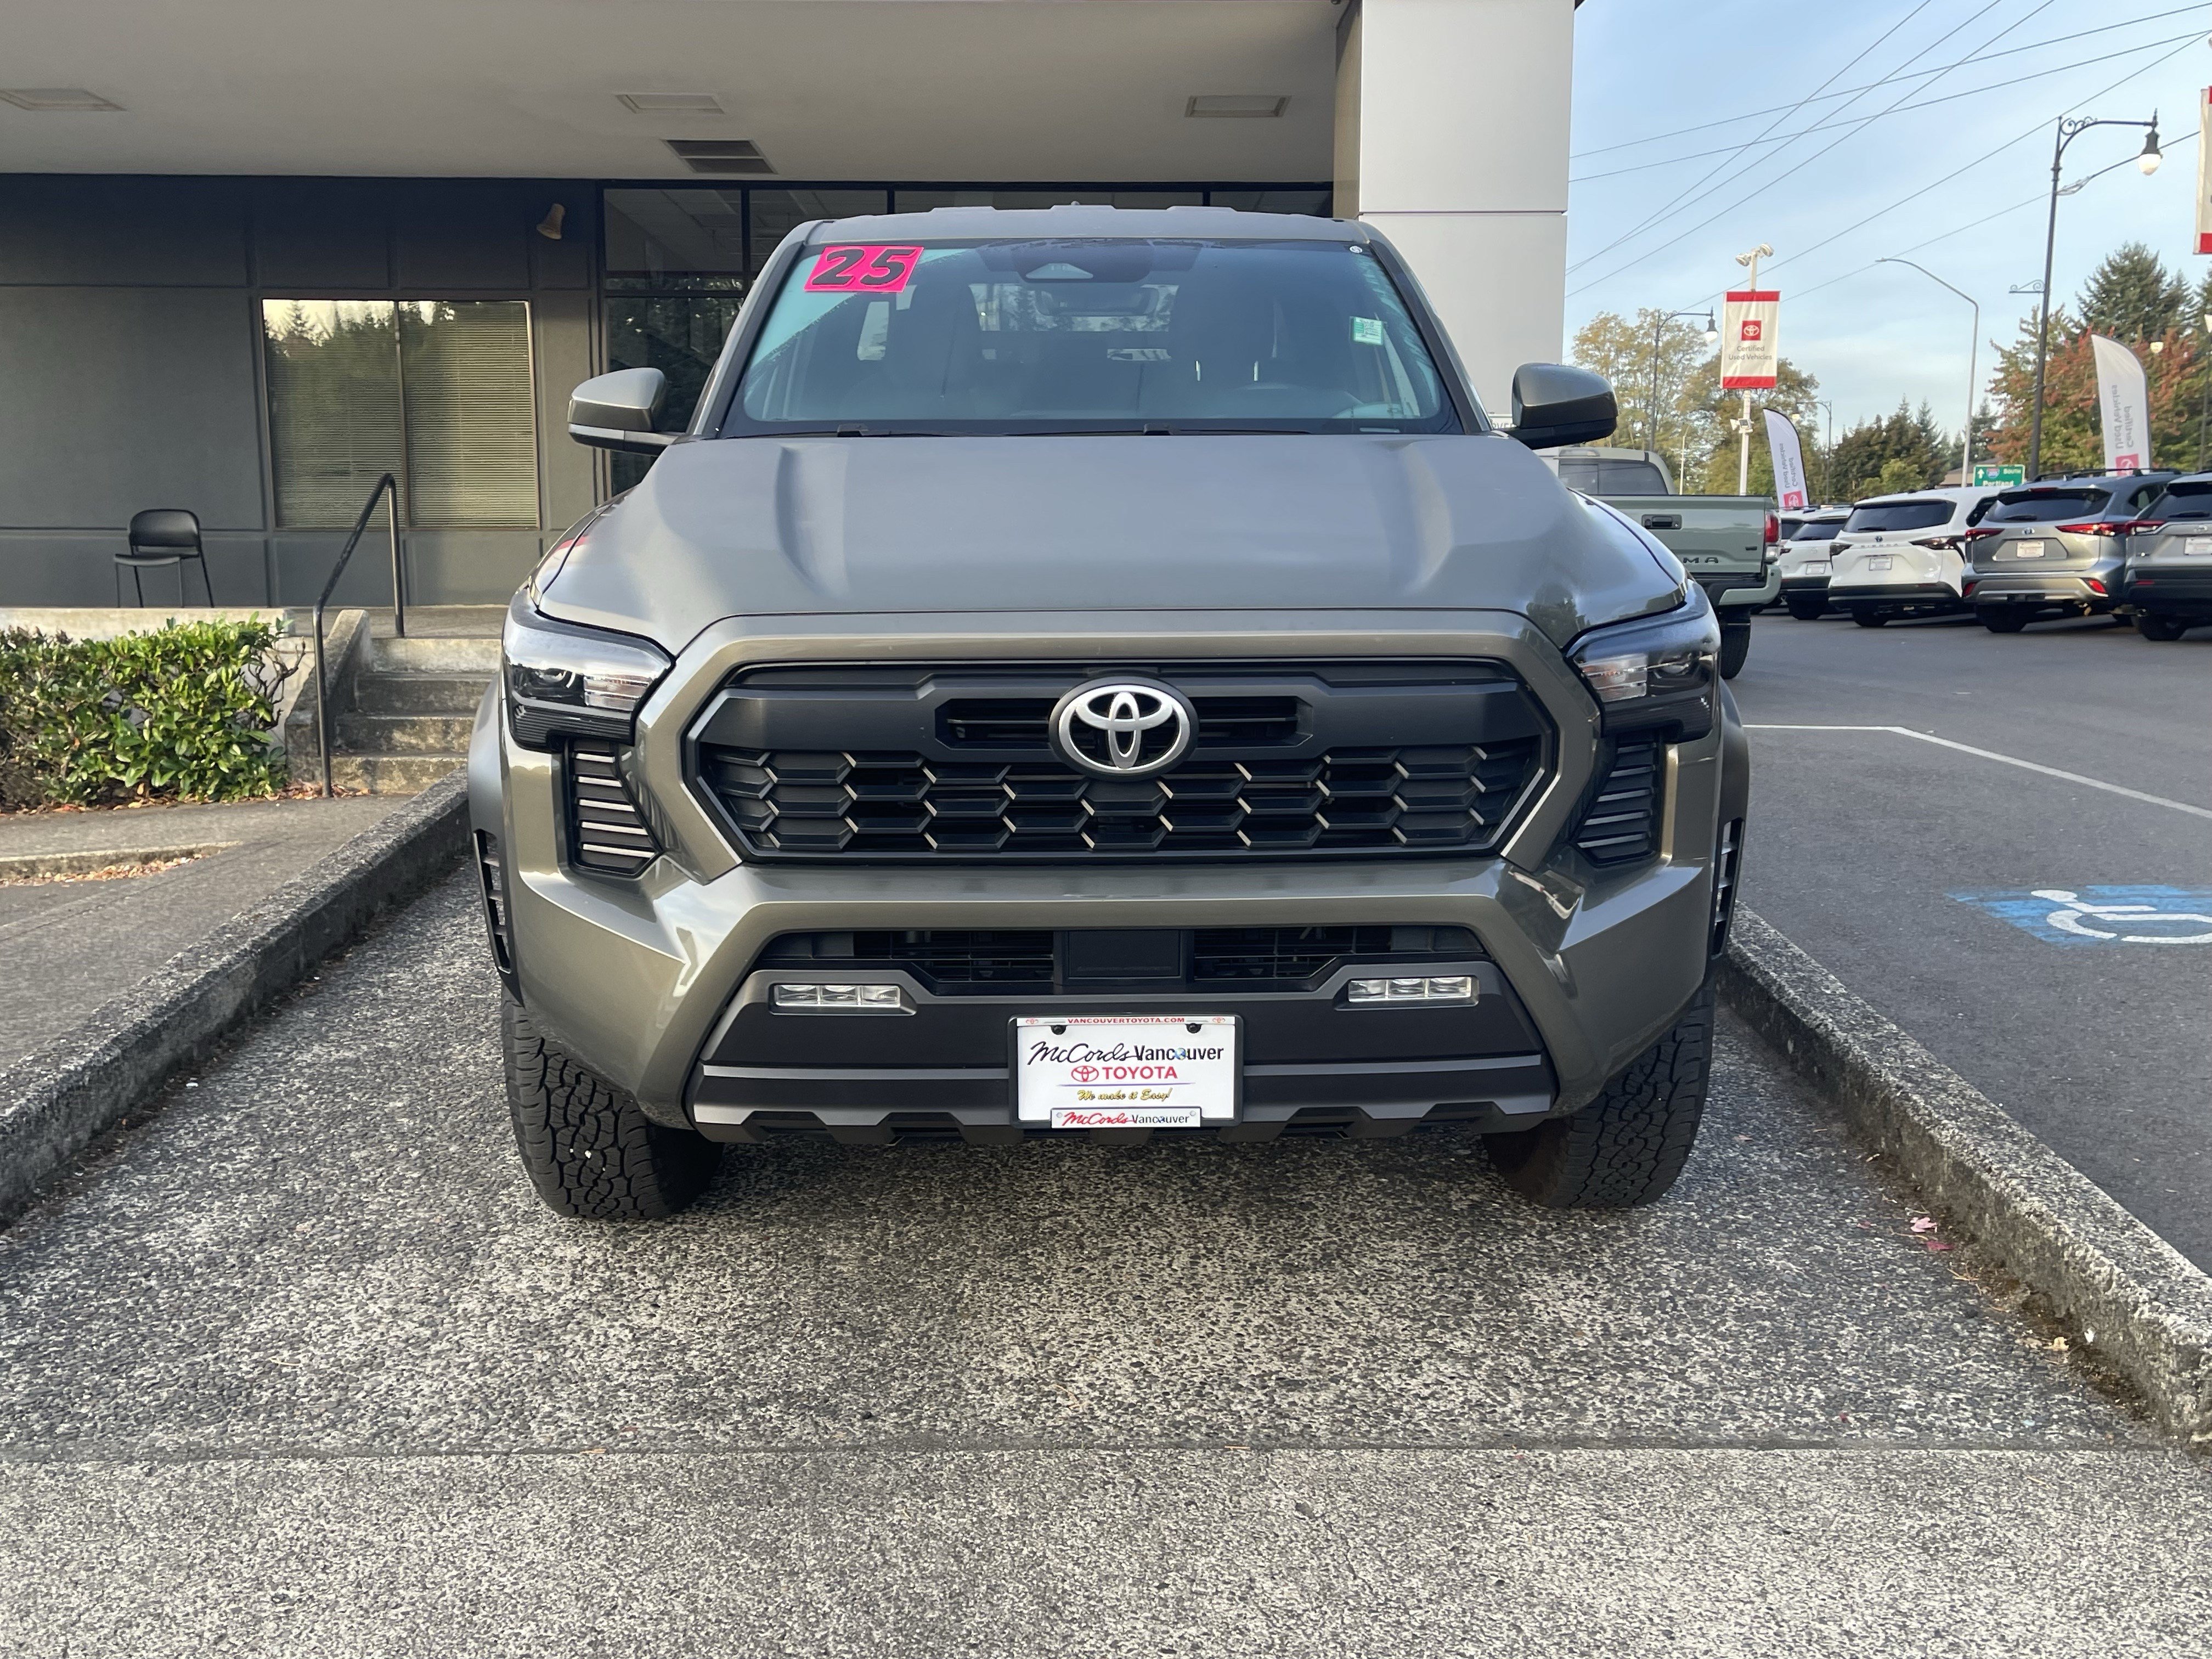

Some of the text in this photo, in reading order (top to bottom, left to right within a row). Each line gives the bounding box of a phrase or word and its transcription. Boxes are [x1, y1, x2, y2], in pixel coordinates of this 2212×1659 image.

[812, 249, 917, 286] 25
[1102, 1066, 1178, 1080] TOYOTA
[1077, 1087, 1173, 1102] We make it Easy!
[1062, 1111, 1133, 1126] McCords
